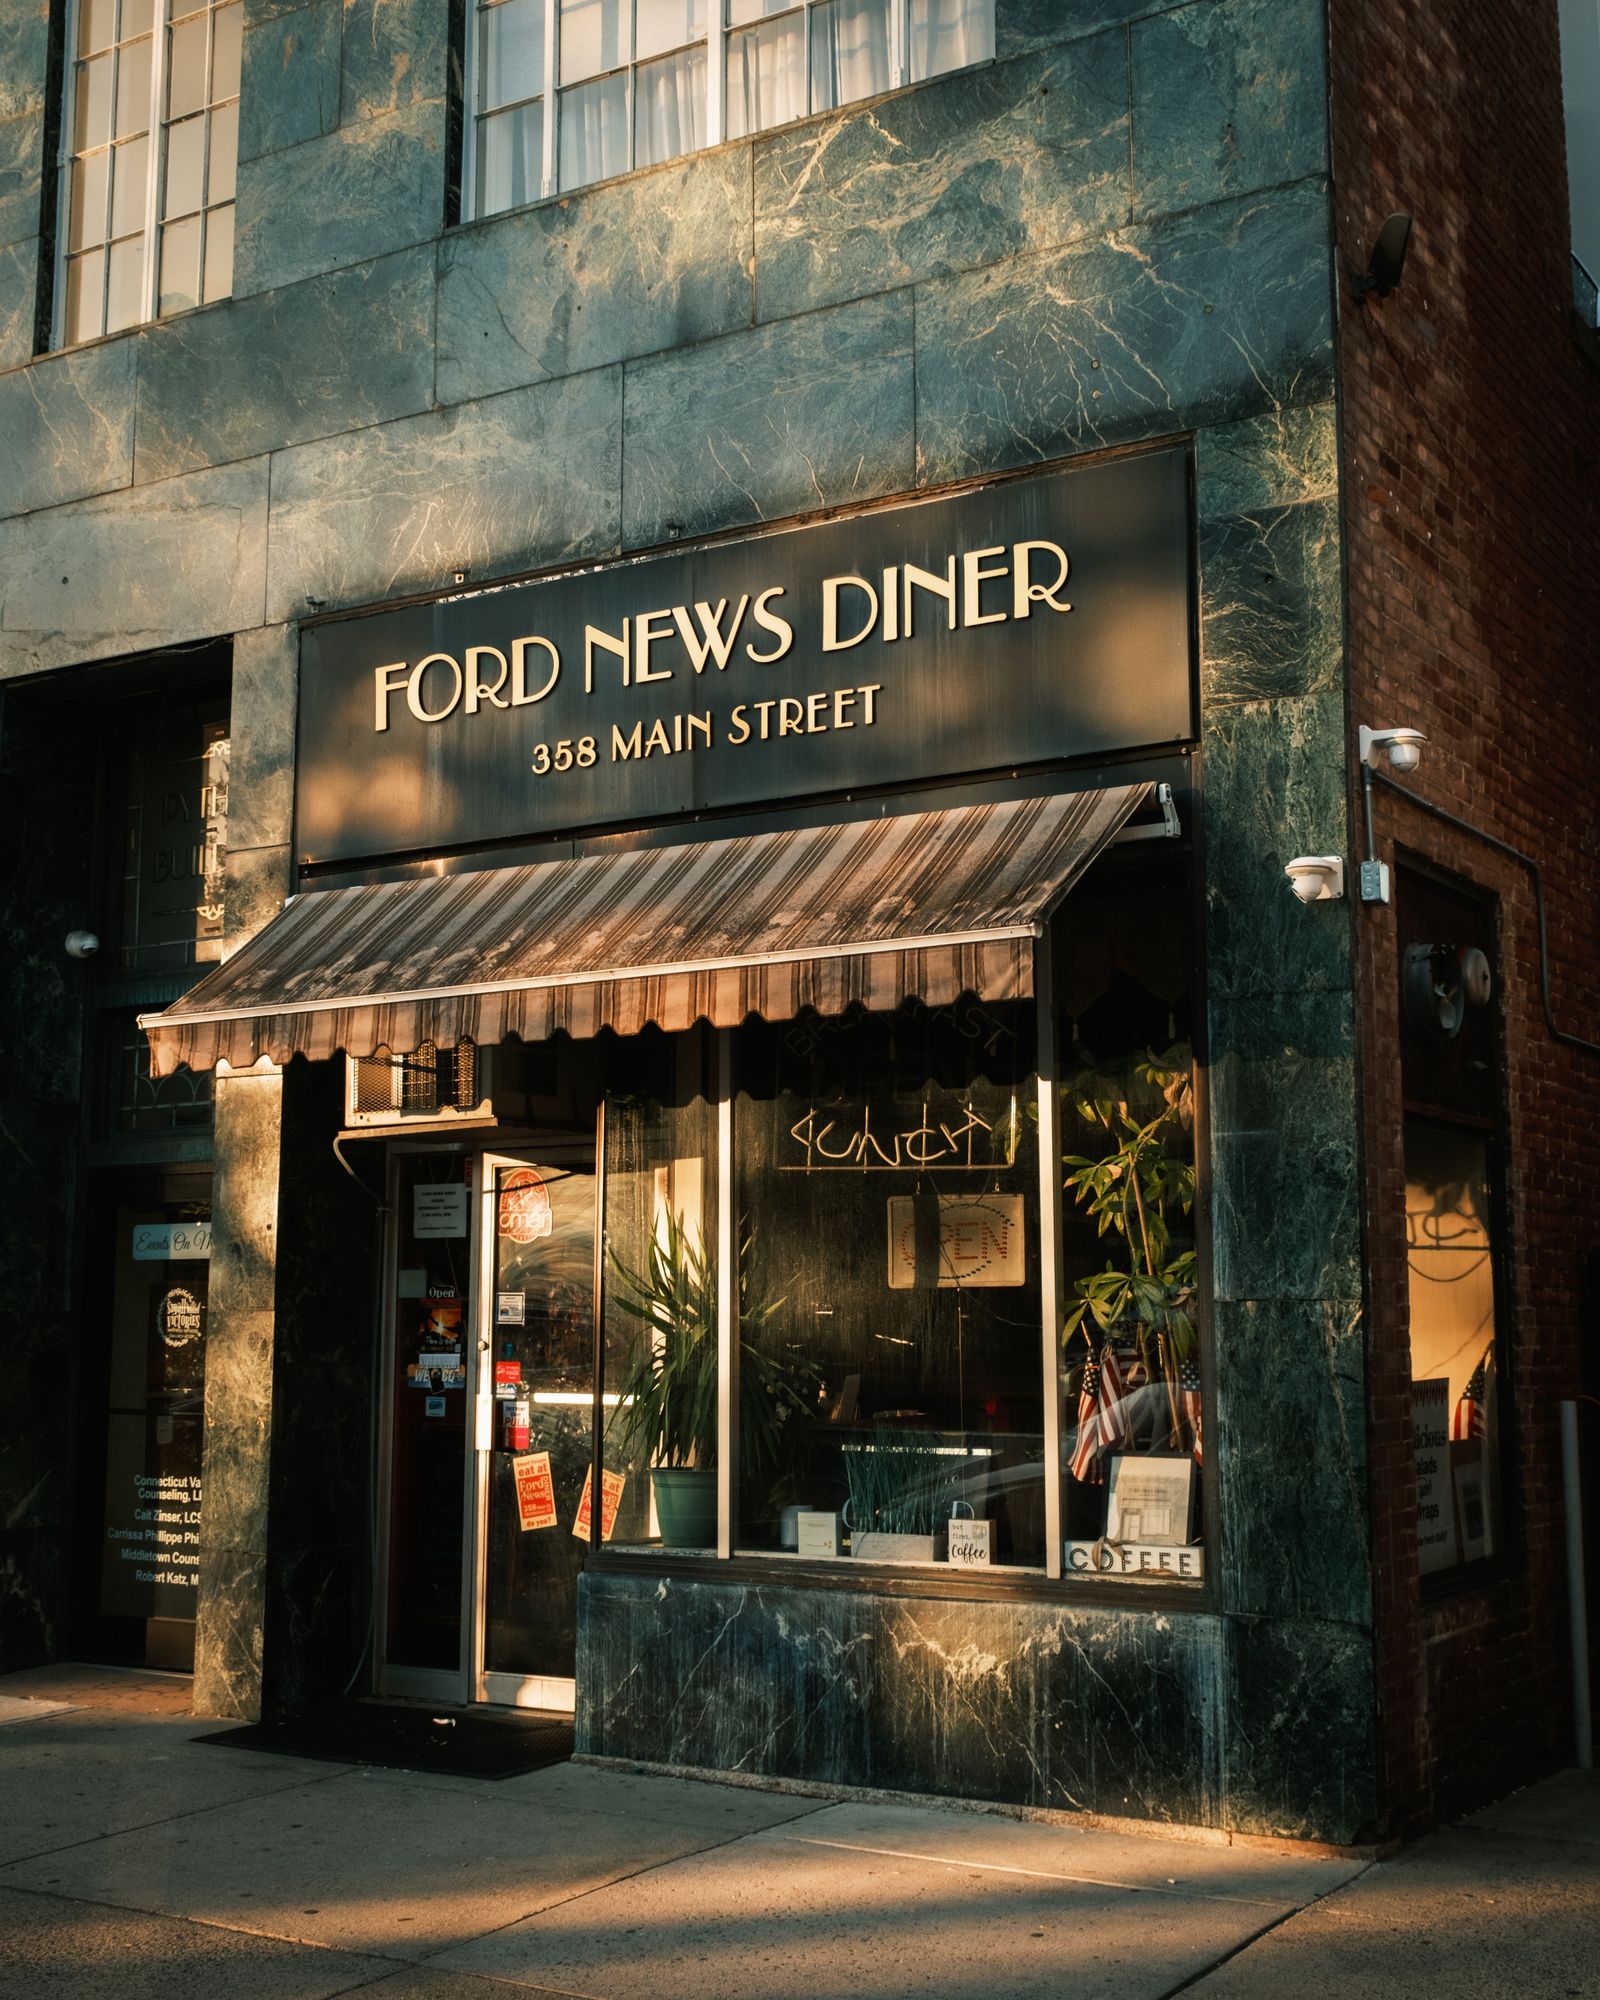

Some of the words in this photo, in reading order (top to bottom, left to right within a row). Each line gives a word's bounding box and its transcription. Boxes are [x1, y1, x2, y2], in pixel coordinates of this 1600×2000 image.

[375, 635, 561, 732] FORD
[585, 586, 794, 694] NEWS
[822, 540, 1073, 652] DINER
[531, 736, 597, 775] 358
[611, 710, 711, 763] MAIN
[728, 683, 881, 745] STREET
[790, 1108, 993, 1167] LUNCH
[174, 1231, 191, 1252] On
[428, 1286, 455, 1300] Open
[504, 1416, 528, 1427] PULL
[519, 1464, 534, 1477] eat
[537, 1463, 548, 1474] at
[1416, 1456, 1438, 1476] alads
[134, 1474, 188, 1488] Connecticut
[519, 1475, 544, 1493] Ford
[609, 1480, 620, 1492] at
[138, 1488, 191, 1503] Counseling,
[521, 1491, 546, 1502] News
[134, 1508, 152, 1521] Cait
[153, 1510, 182, 1525] Zinser,
[107, 1527, 143, 1541] Carrissa
[121, 1548, 171, 1563] Middletown
[951, 1542, 987, 1565] Coffee
[135, 1569, 165, 1583] Robert
[166, 1572, 189, 1587] Katz,
